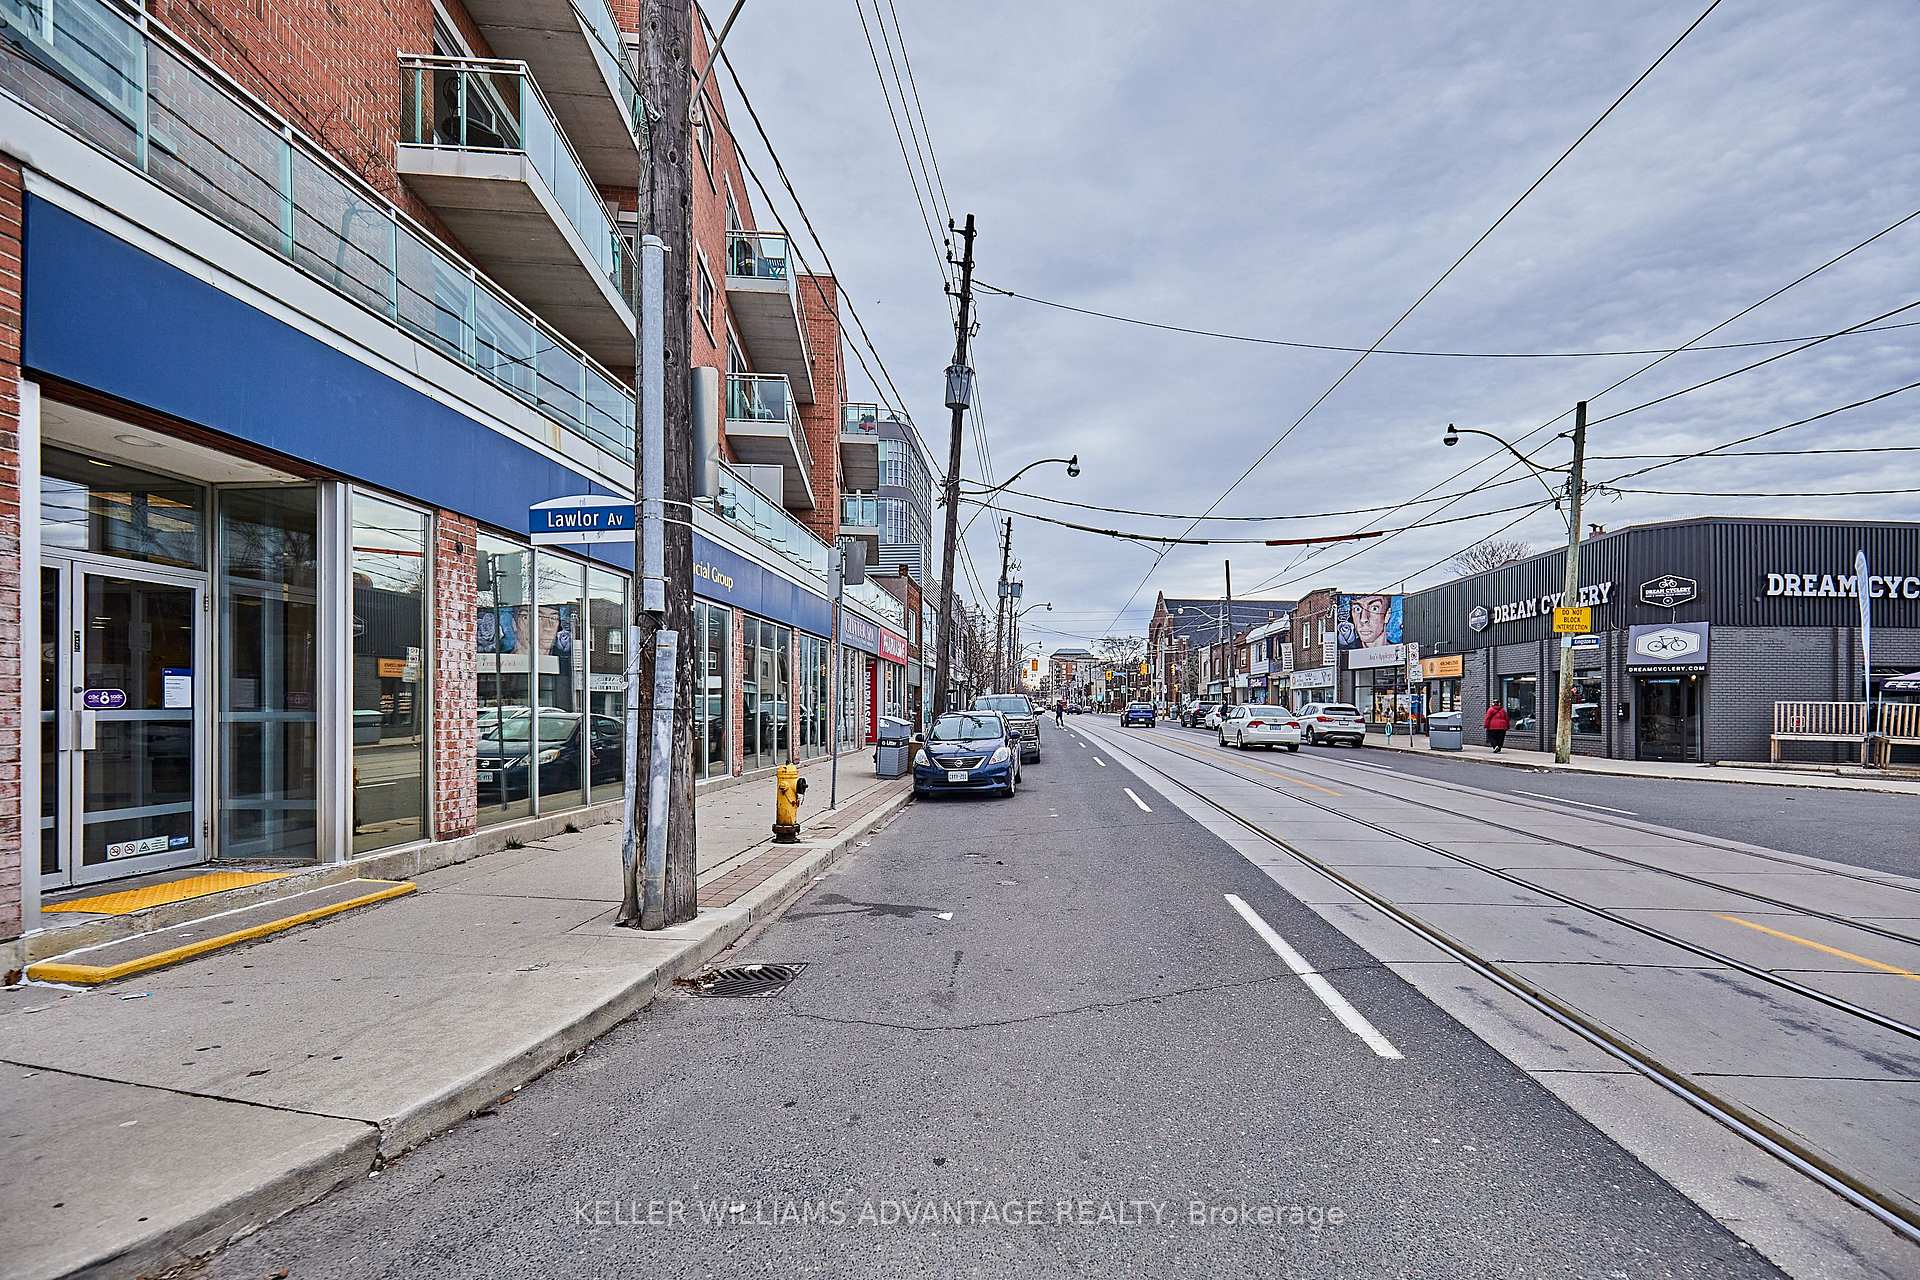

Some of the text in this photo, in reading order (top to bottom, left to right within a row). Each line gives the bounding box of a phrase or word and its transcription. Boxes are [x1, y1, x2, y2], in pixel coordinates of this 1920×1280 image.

[547, 511, 623, 528] Lawlor Av
[711, 566, 734, 592] Group
[1767, 573, 1858, 597] DREAM
[1493, 581, 1612, 624] DREAM CYERY
[1628, 665, 1706, 673] DREAMCYCLERY.COM
